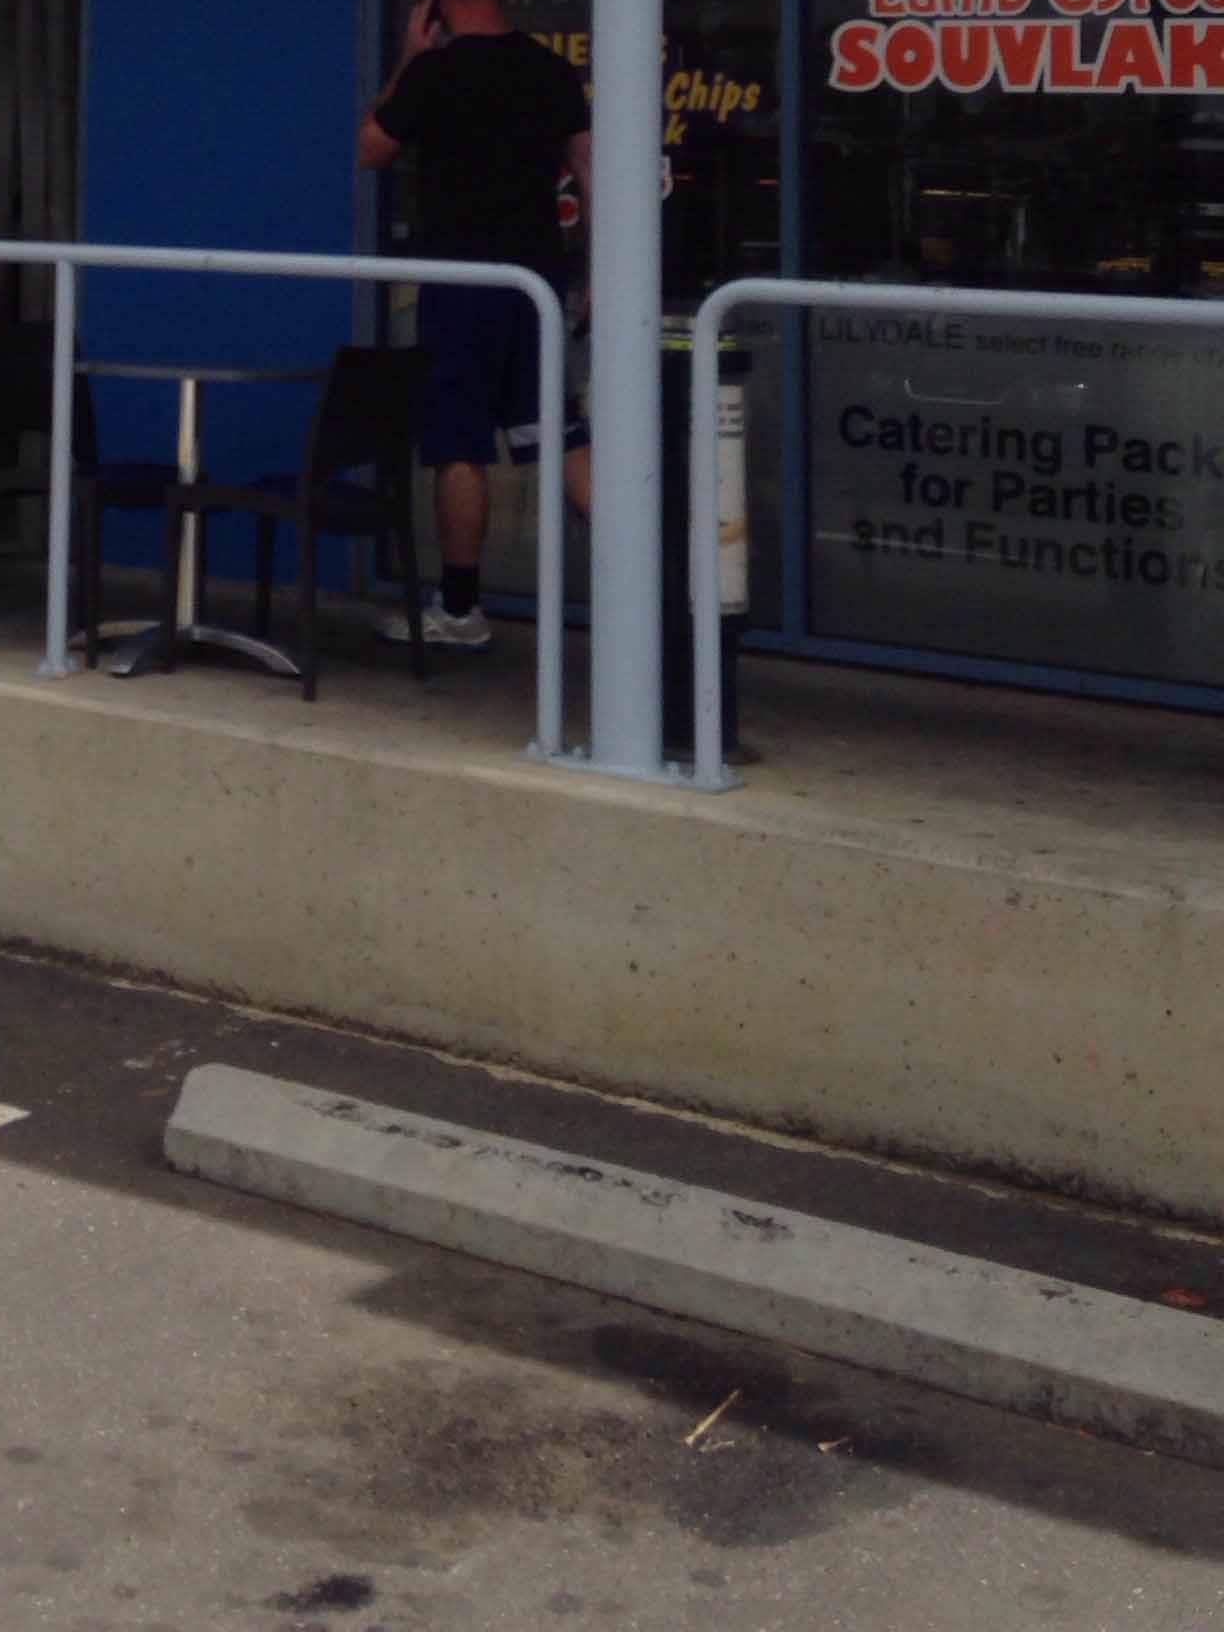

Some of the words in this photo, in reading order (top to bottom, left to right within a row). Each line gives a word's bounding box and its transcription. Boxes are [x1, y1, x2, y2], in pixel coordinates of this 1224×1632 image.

[664, 68, 761, 124] Chips
[817, 316, 964, 352] LILYDALE
[974, 333, 1049, 356] select
[838, 405, 1064, 476] Catering
[900, 463, 968, 508] for
[992, 471, 1183, 532] Parties
[849, 518, 945, 560] and
